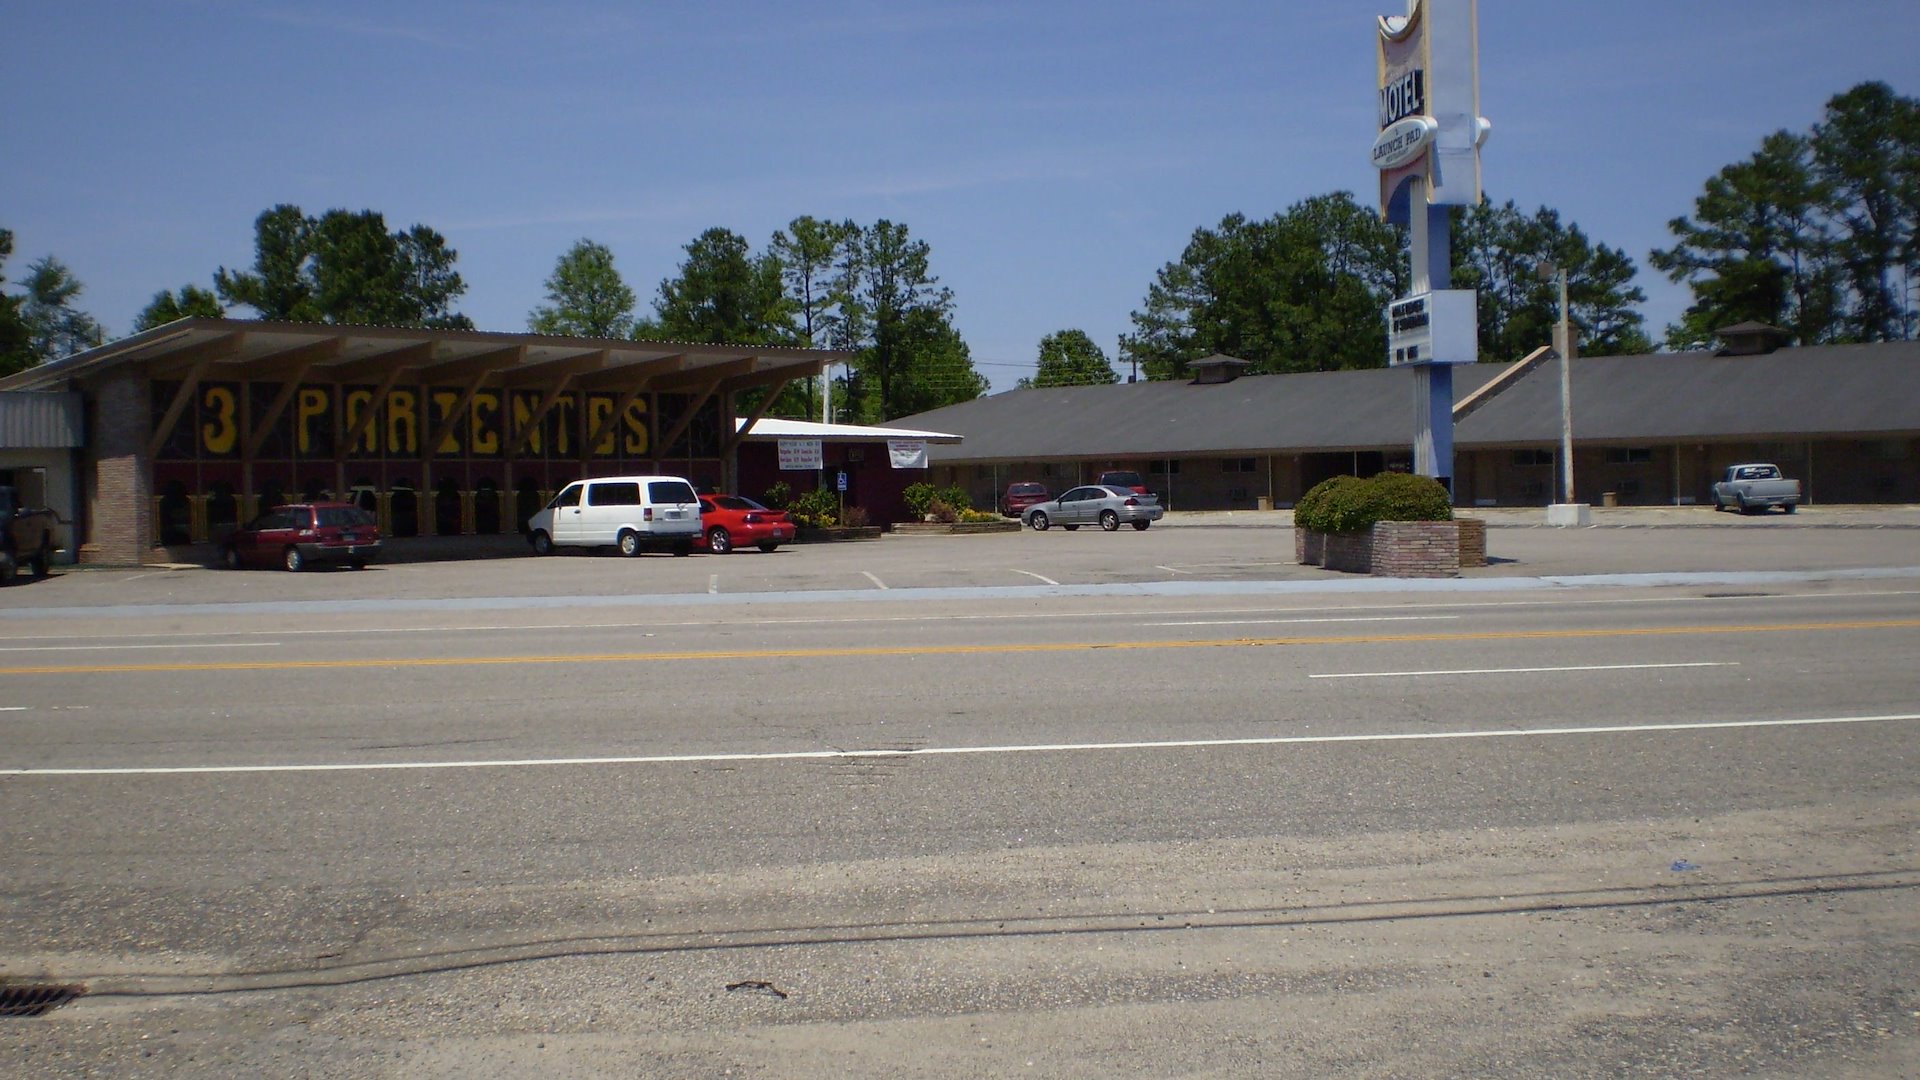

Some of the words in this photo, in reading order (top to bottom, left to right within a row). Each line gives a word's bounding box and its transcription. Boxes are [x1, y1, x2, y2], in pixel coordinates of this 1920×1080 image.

[1380, 71, 1420, 126] MOTEL
[1374, 136, 1403, 160] LAUNCH
[1406, 128, 1421, 145] PAD
[204, 387, 238, 454] 3
[299, 388, 649, 455] PARIENTES
